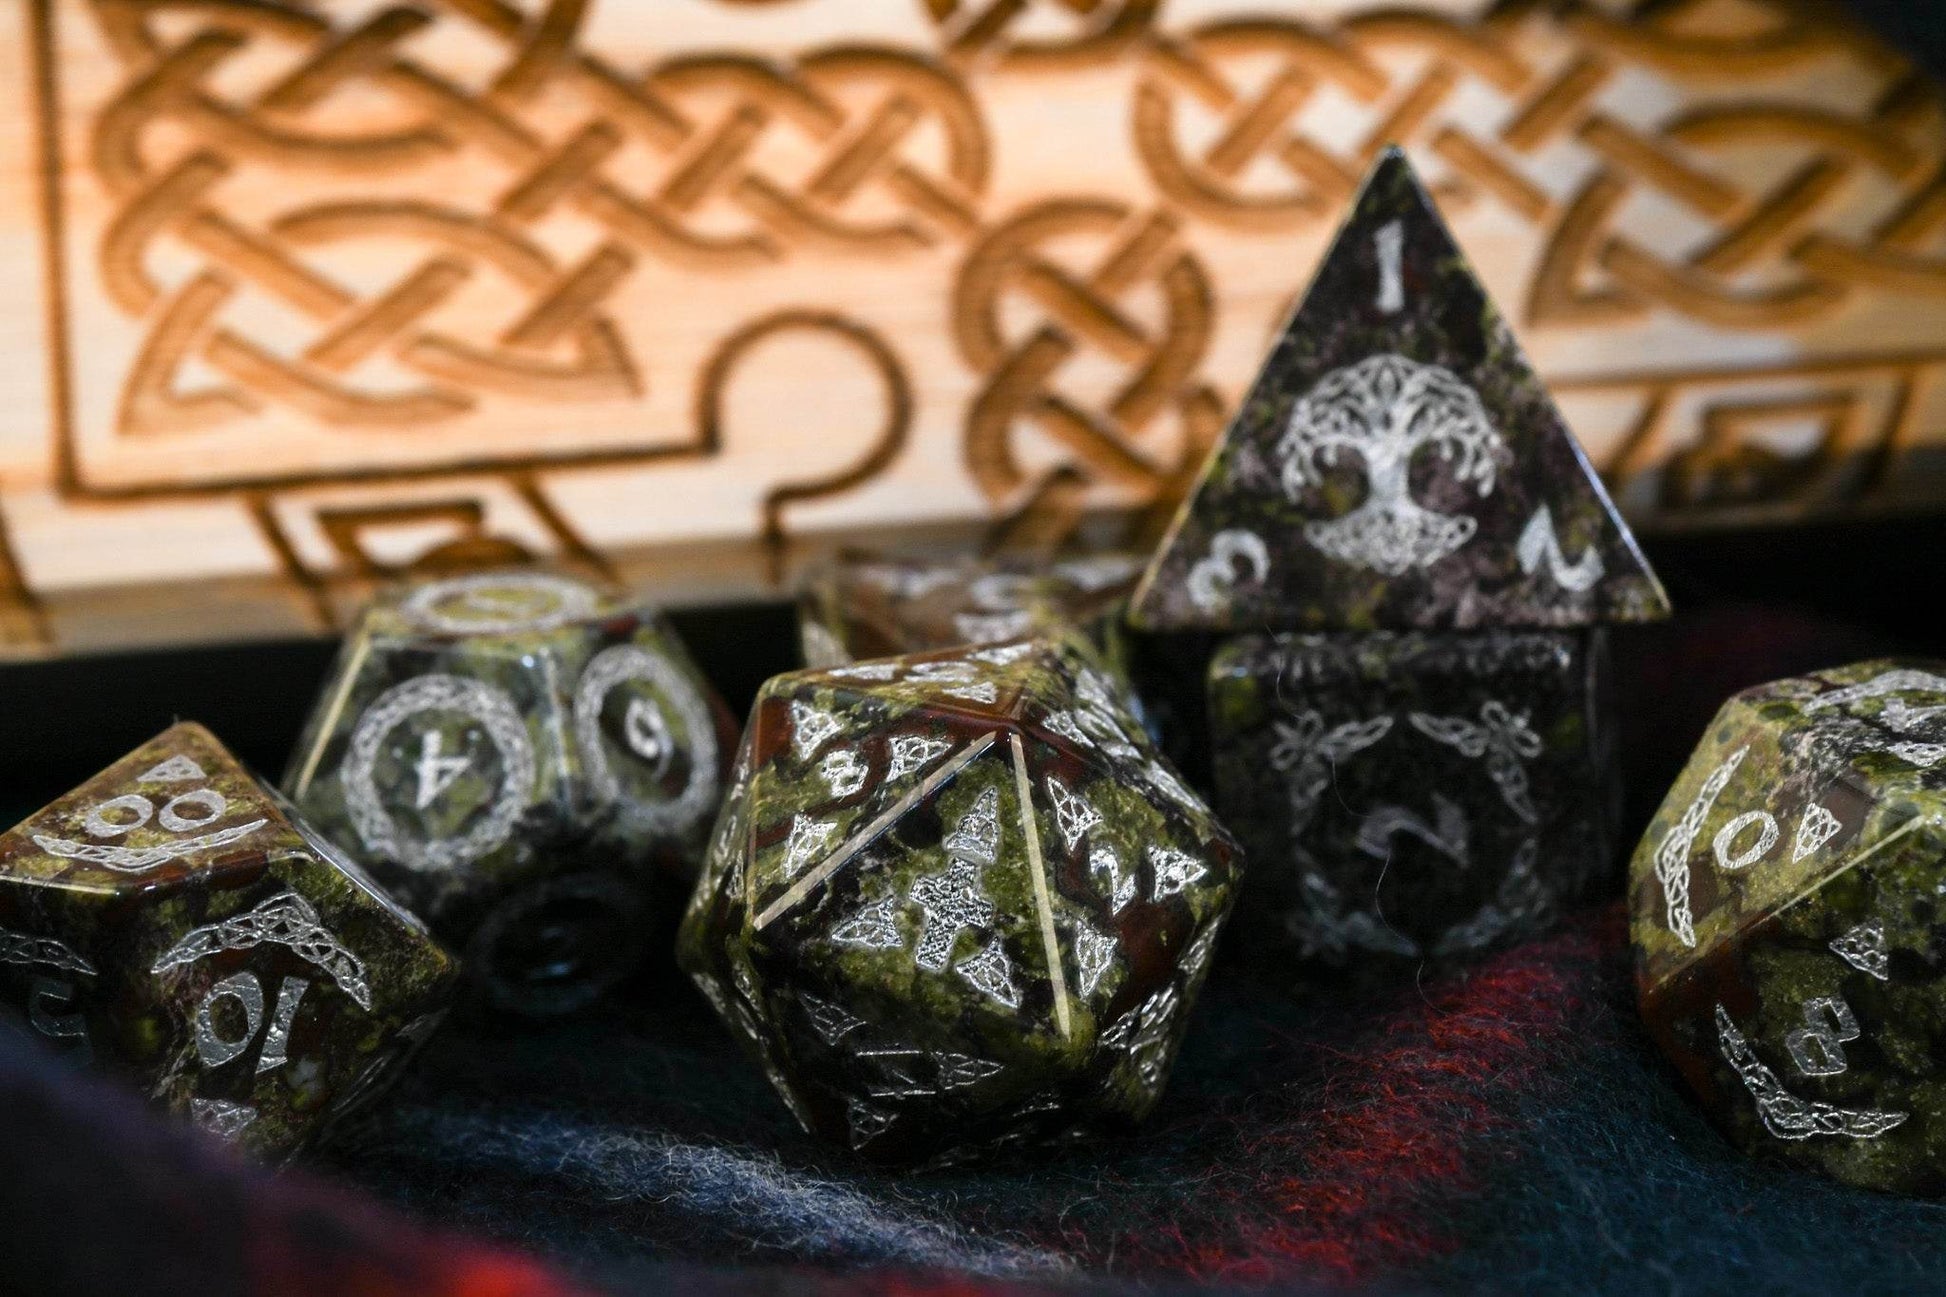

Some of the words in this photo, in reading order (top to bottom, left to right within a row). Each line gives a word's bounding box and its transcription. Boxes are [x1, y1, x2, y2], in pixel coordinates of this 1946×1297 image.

[1375, 220, 1405, 312] 1
[1187, 529, 1271, 606] 3
[414, 730, 473, 809] 4
[821, 750, 869, 798] 8
[85, 789, 228, 837] 00
[1713, 811, 1780, 869] 0
[1786, 997, 1861, 1077] 8
